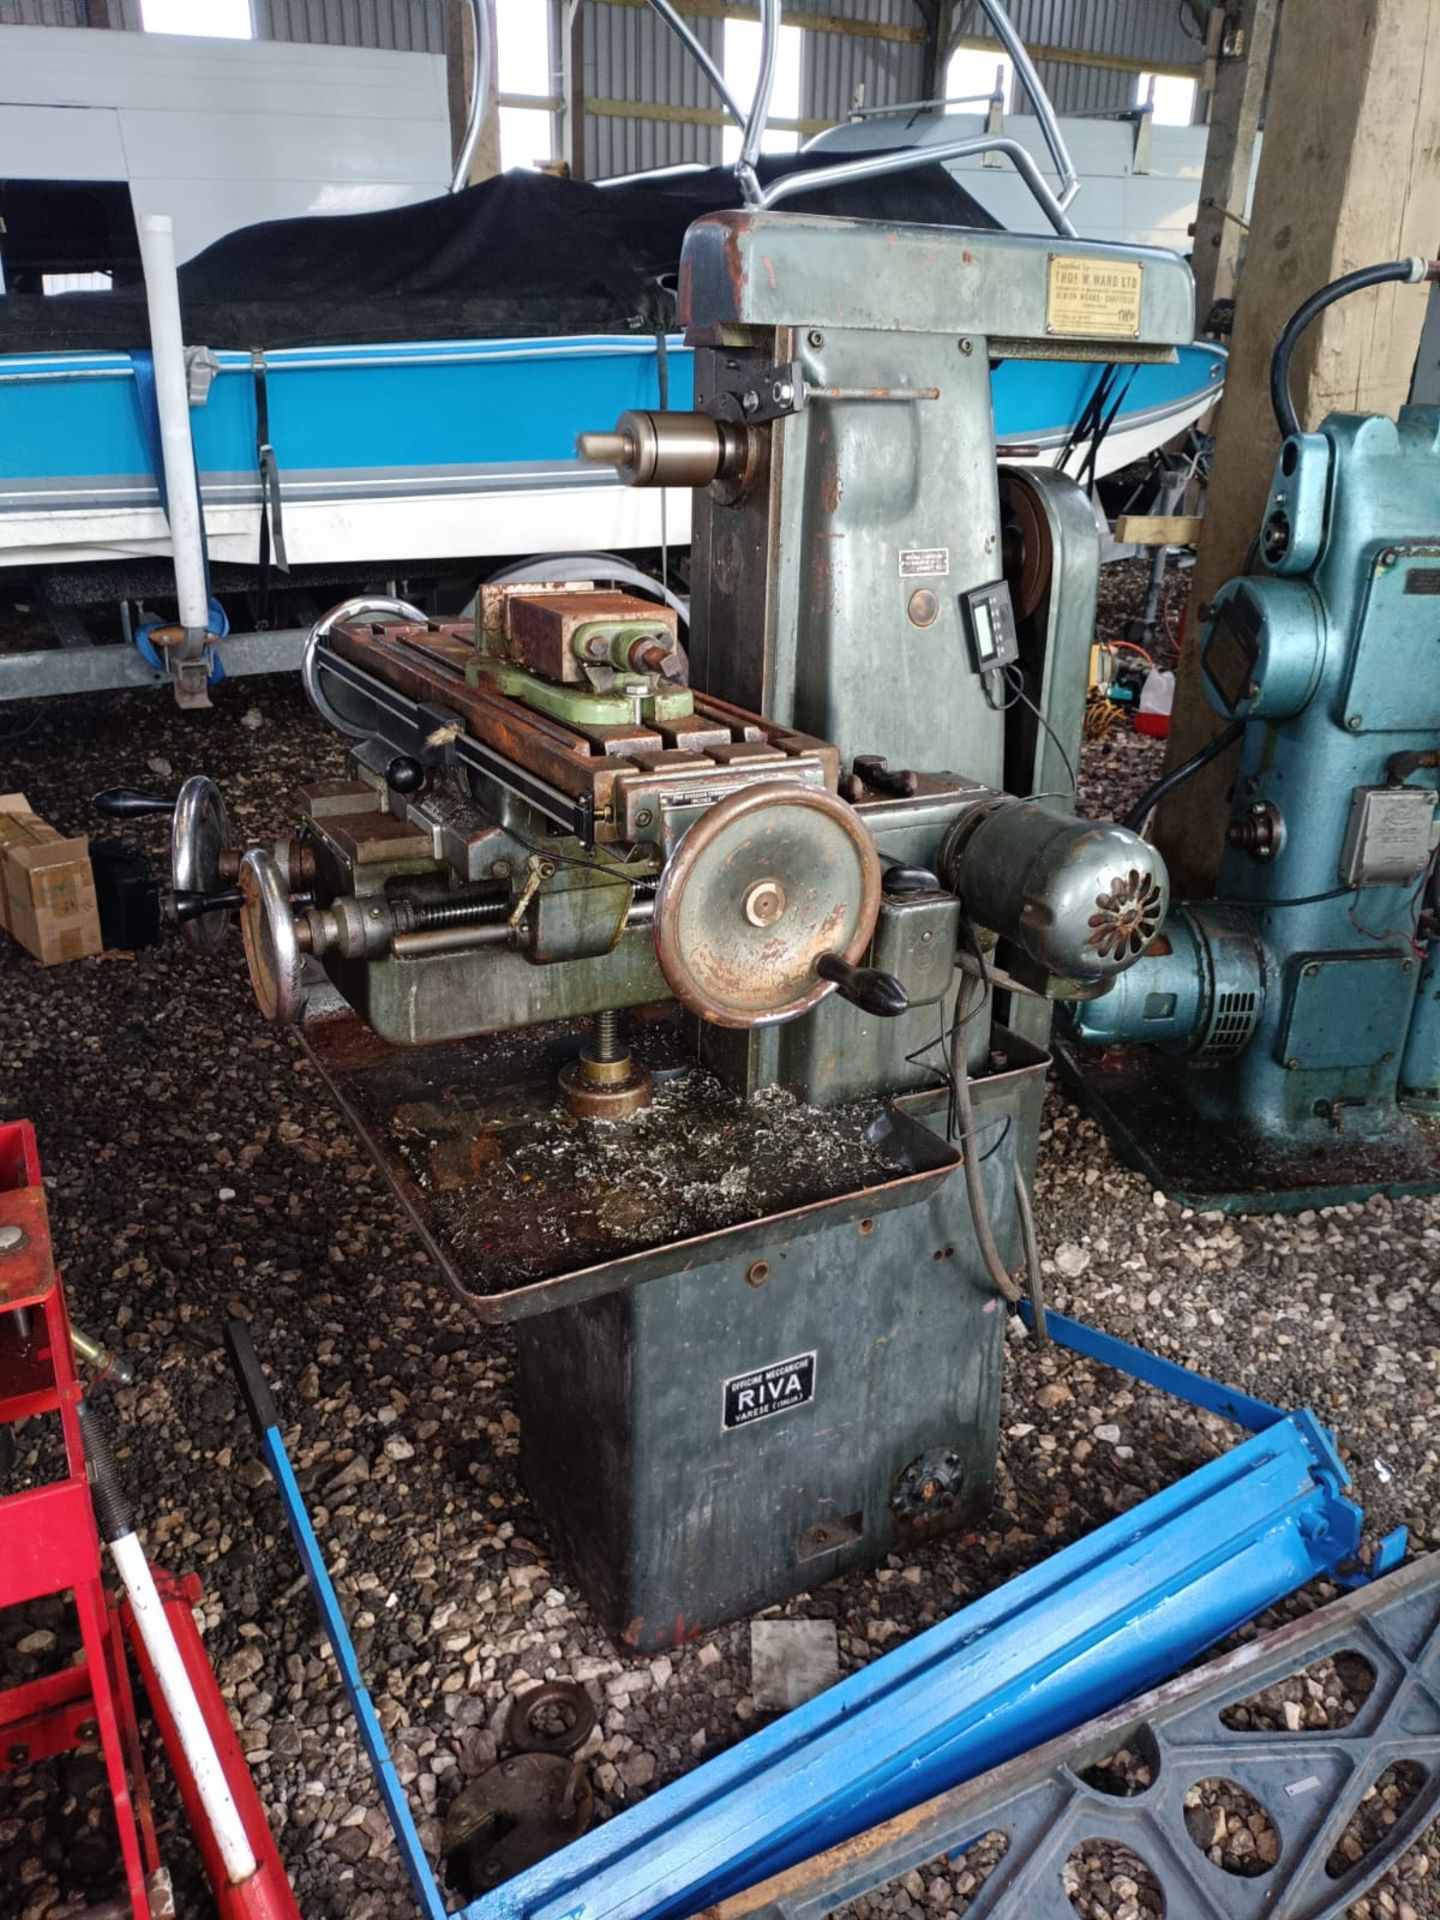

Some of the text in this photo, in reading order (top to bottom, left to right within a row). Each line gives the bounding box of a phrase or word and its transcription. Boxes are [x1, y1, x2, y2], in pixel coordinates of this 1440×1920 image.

[1093, 275, 1119, 288] WARD
[1121, 276, 1138, 289] LTD
[731, 1359, 809, 1393] OFFICINE MECCANICHE
[739, 1373, 802, 1411] RIVA
[735, 1403, 770, 1422] VARESE
